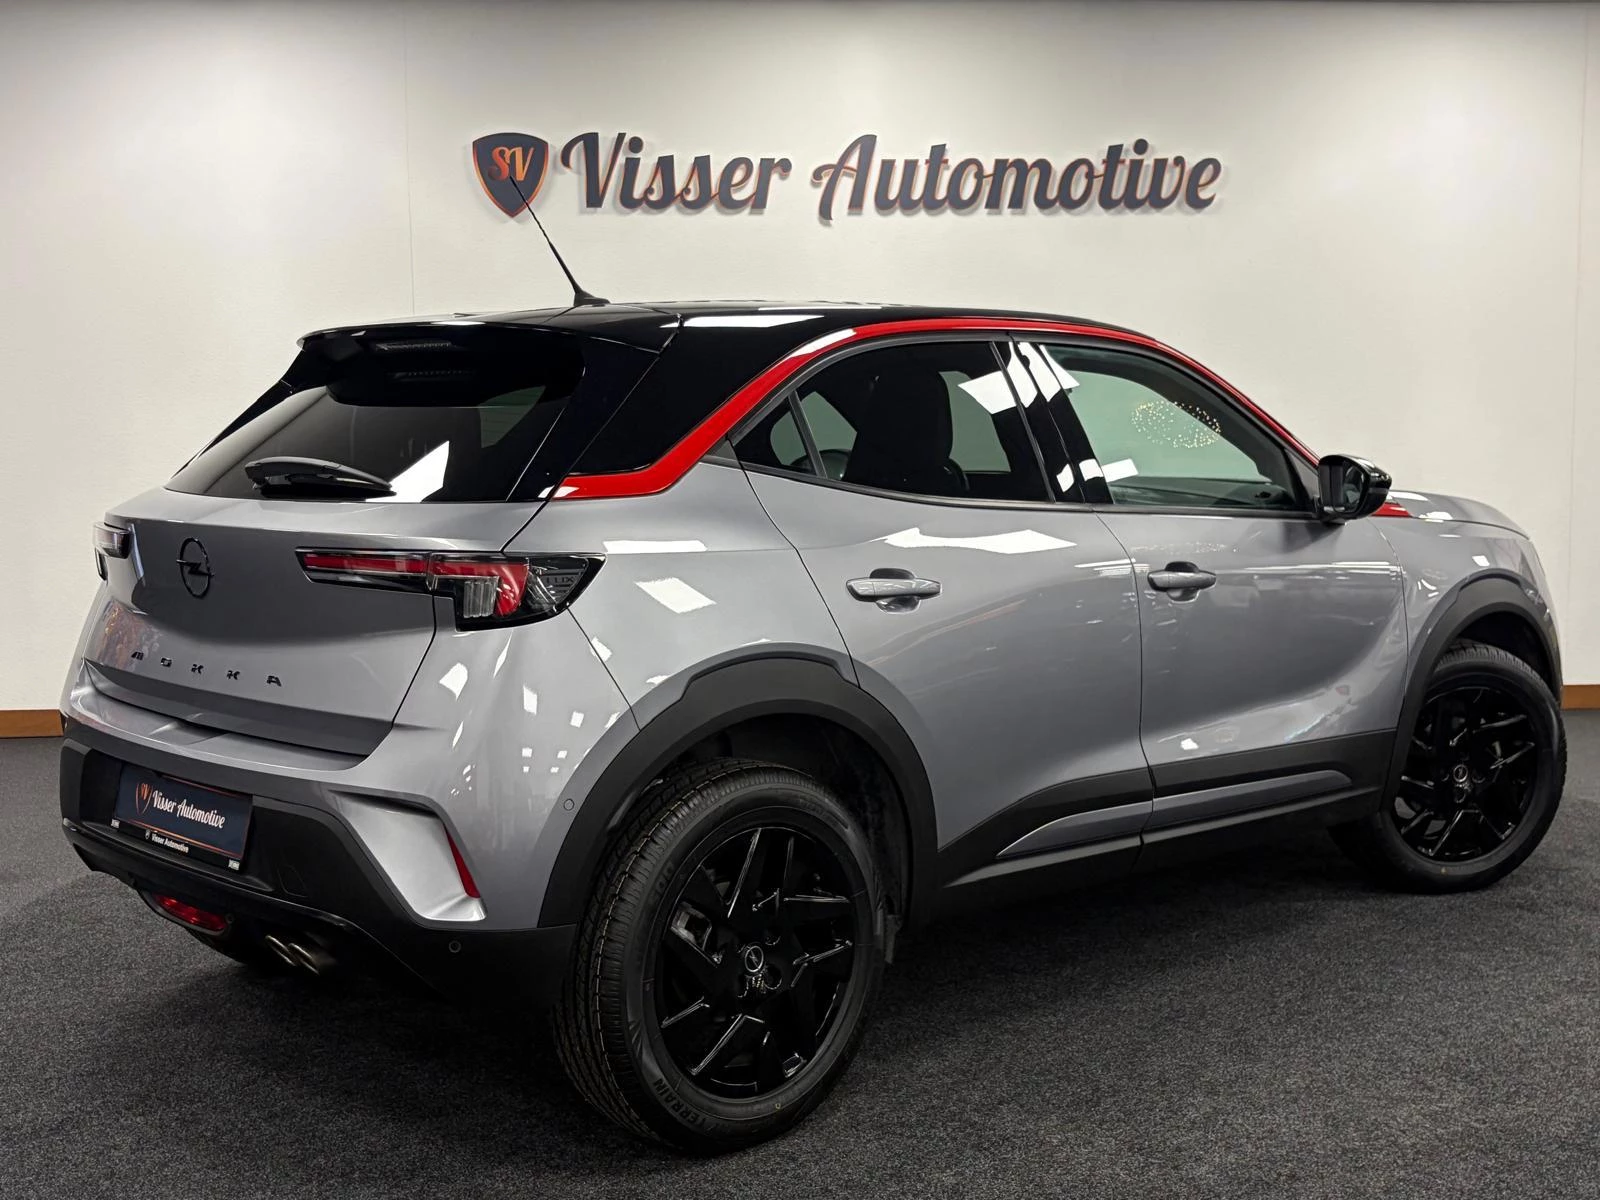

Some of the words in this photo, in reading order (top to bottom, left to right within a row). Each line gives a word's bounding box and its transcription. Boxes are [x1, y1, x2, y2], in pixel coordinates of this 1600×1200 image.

[487, 145, 535, 182] SV
[560, 131, 793, 210] Visser
[811, 133, 1222, 222] Automotive
[131, 651, 282, 687] MOKKA
[152, 789, 177, 814] Visser
[176, 798, 226, 829] Automotive
[164, 837, 190, 854] Automotive
